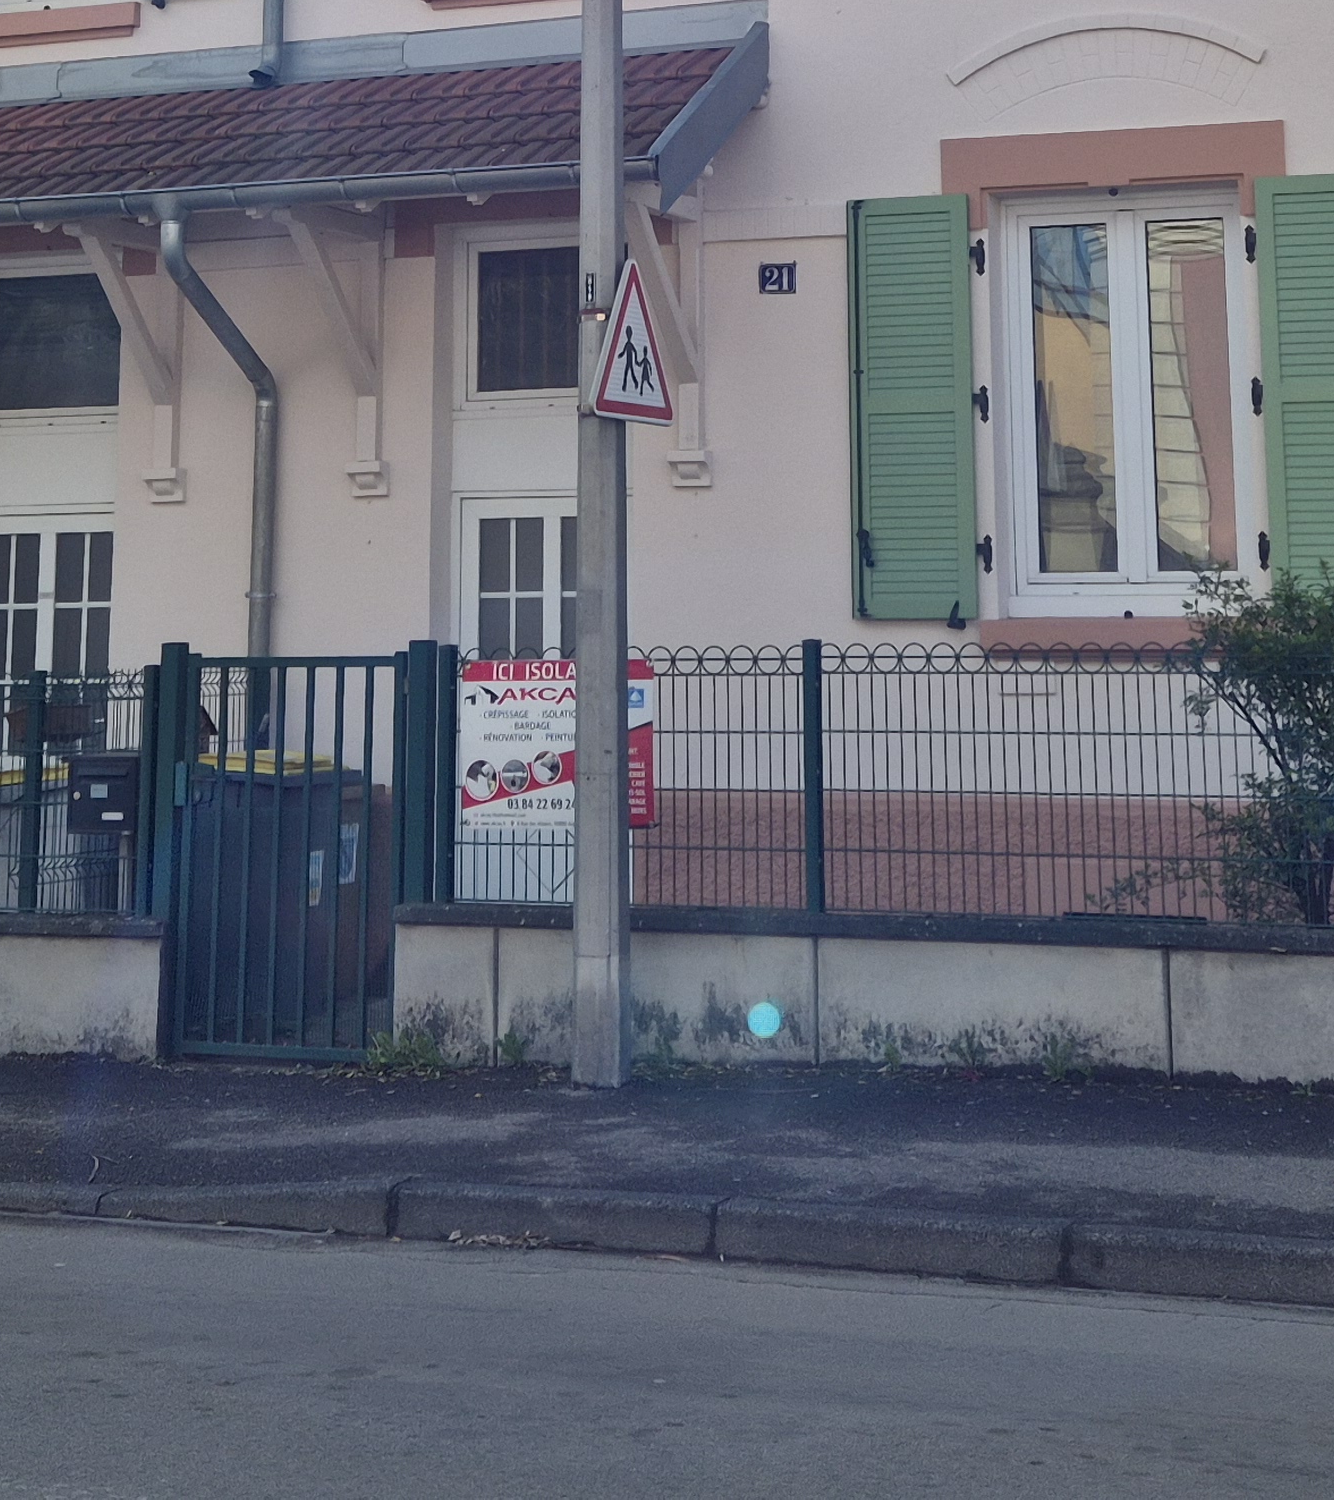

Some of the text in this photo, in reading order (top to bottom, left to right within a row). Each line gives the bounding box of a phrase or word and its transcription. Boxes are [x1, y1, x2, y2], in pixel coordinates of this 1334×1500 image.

[764, 266, 790, 291] 21
[492, 661, 577, 681] ICI ISOLA
[496, 686, 577, 706] AKCA
[541, 709, 577, 719] ISOLATIO
[513, 721, 552, 731] BARDAGE
[483, 731, 575, 742] RÉNOVATION PEINTU
[507, 798, 519, 810] 03
[521, 798, 534, 810] 84
[536, 798, 548, 810] 22
[550, 798, 563, 810] 69
